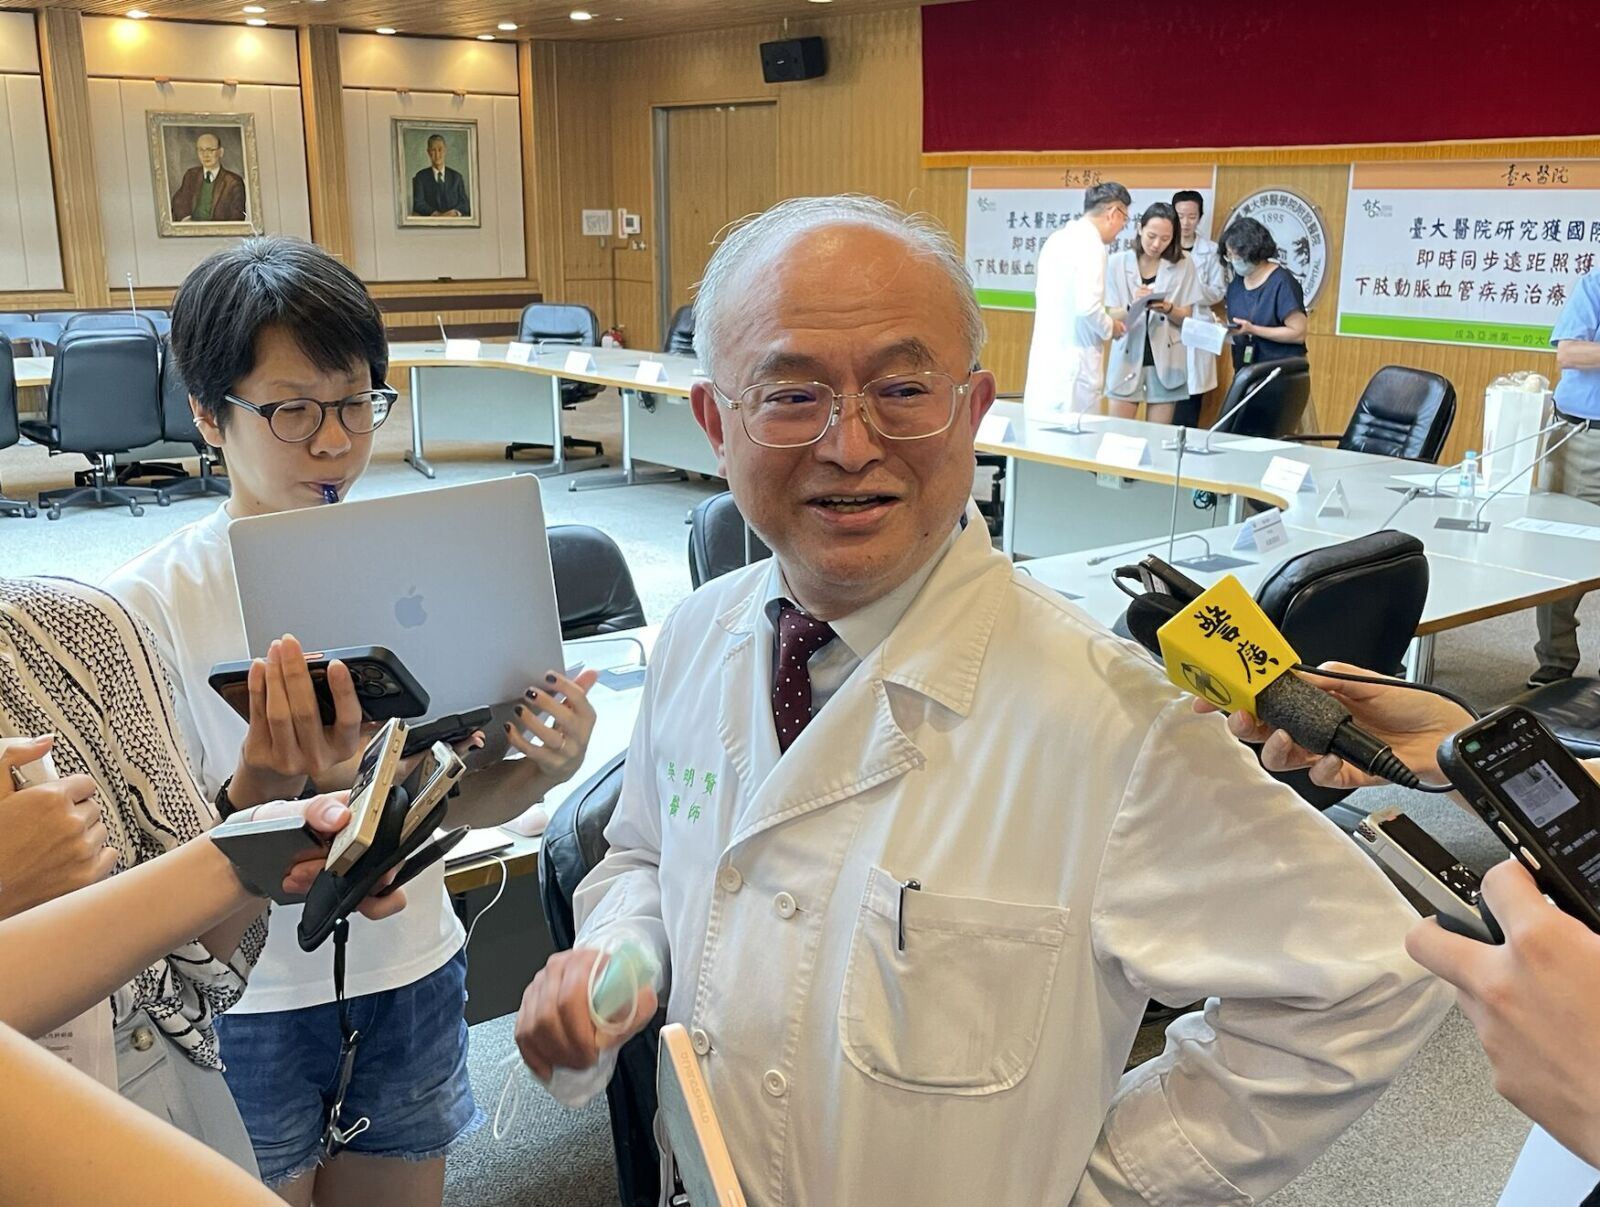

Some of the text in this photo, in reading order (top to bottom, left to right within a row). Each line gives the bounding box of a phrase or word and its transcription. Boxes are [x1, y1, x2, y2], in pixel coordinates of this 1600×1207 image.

[1501, 163, 1569, 187] 臺大醫院
[1262, 212, 1285, 224] 1895
[975, 258, 1035, 276] 下肢動脈血
[1416, 248, 1595, 276] 即時同步遠距照護
[1355, 276, 1567, 307] 下肢動脈血管疾病治療
[1193, 605, 1280, 684] 警廣
[667, 761, 717, 796] 吳明賢
[669, 794, 701, 824] 醫師
